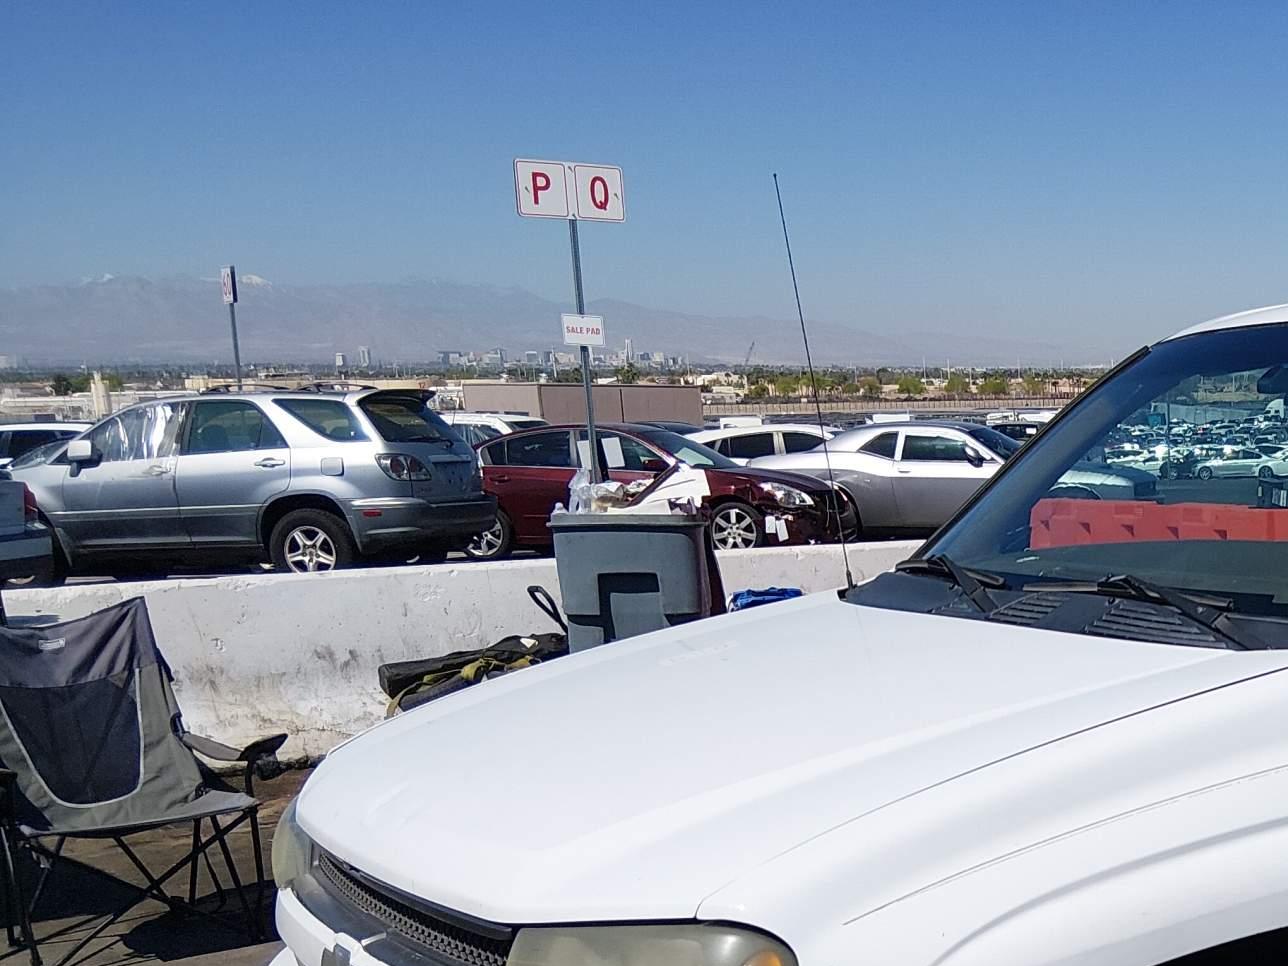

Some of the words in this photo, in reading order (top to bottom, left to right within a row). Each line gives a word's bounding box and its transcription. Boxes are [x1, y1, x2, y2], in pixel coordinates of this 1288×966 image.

[531, 172, 551, 205] P
[590, 175, 609, 211] Q
[565, 326, 585, 335] SALE
[586, 327, 601, 336] PAD
